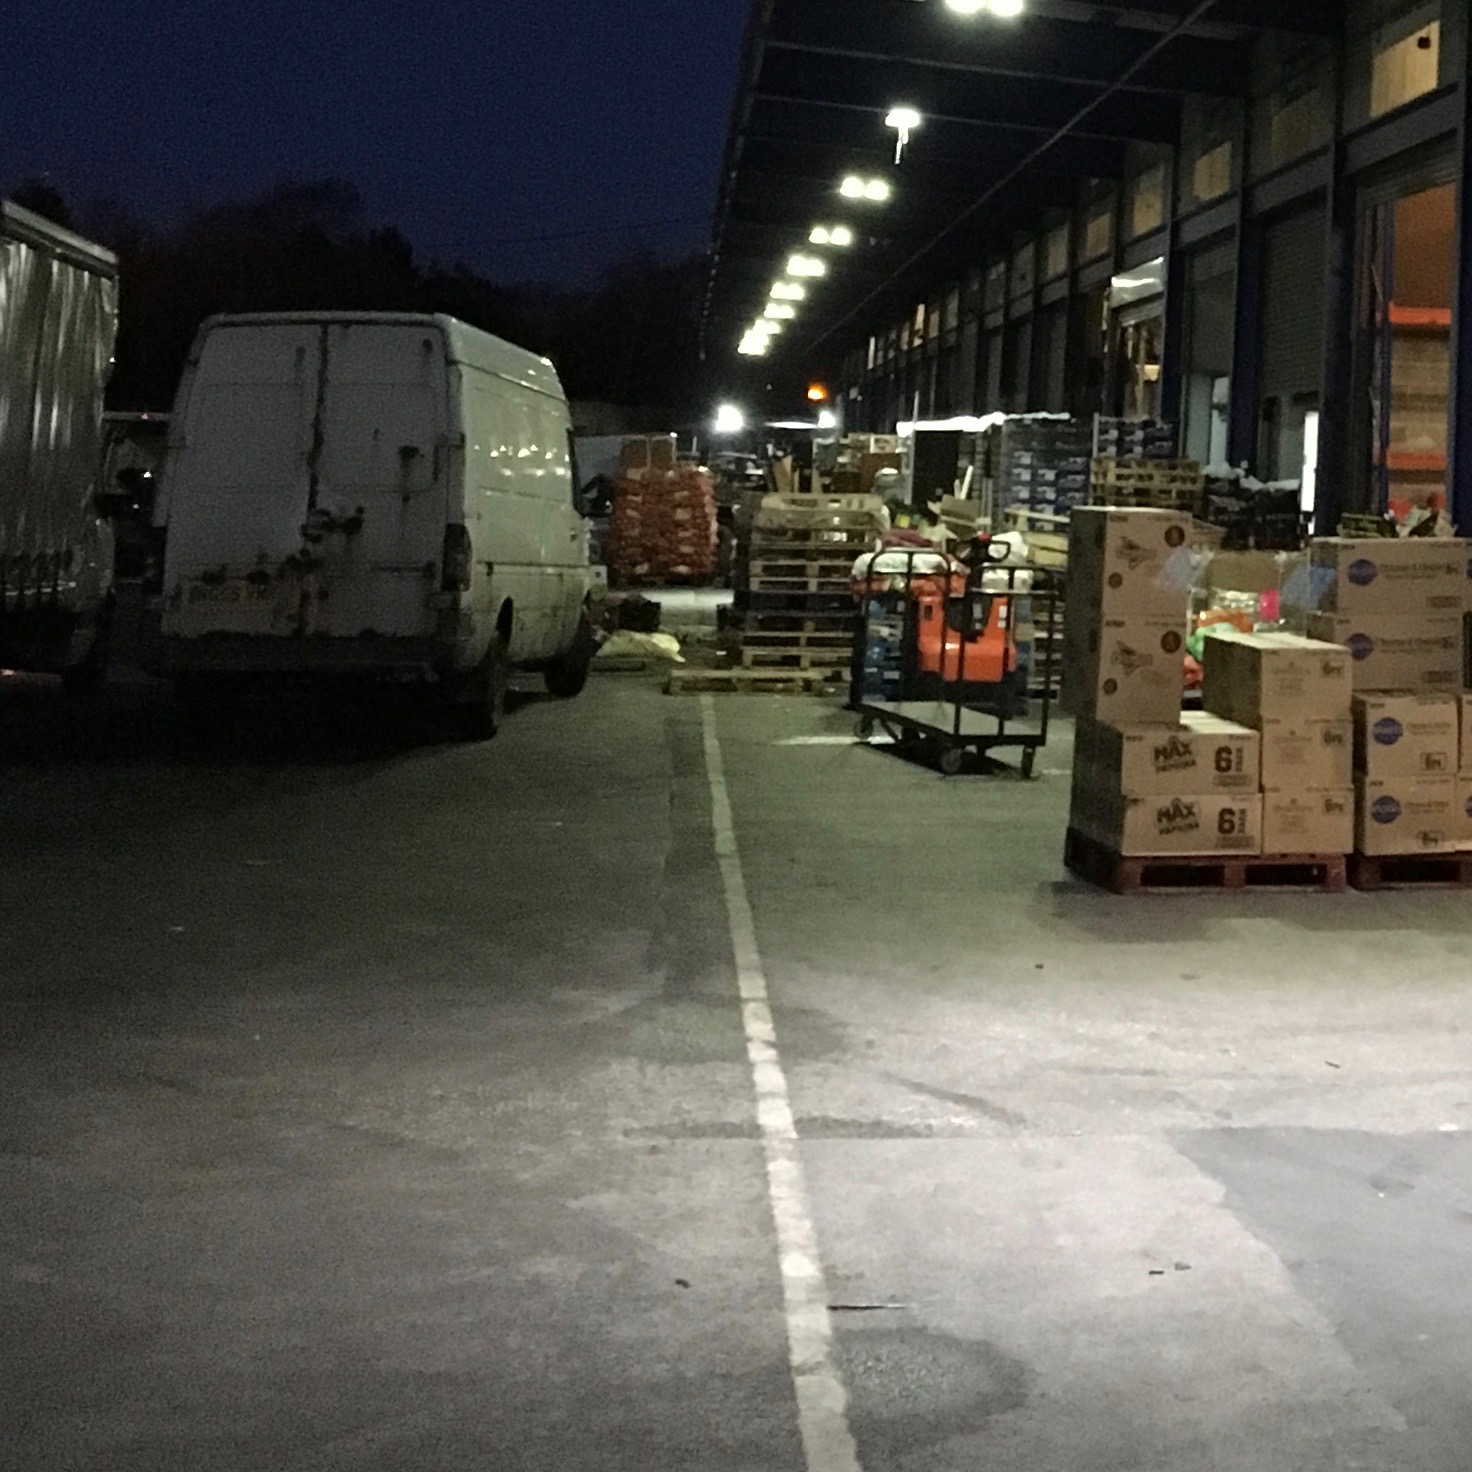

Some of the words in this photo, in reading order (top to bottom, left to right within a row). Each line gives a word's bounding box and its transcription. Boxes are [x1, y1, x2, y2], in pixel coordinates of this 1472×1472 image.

[1154, 736, 1193, 762] MAX
[1214, 745, 1233, 773] 6
[1156, 798, 1196, 824] MAX
[1217, 807, 1236, 835] 6
